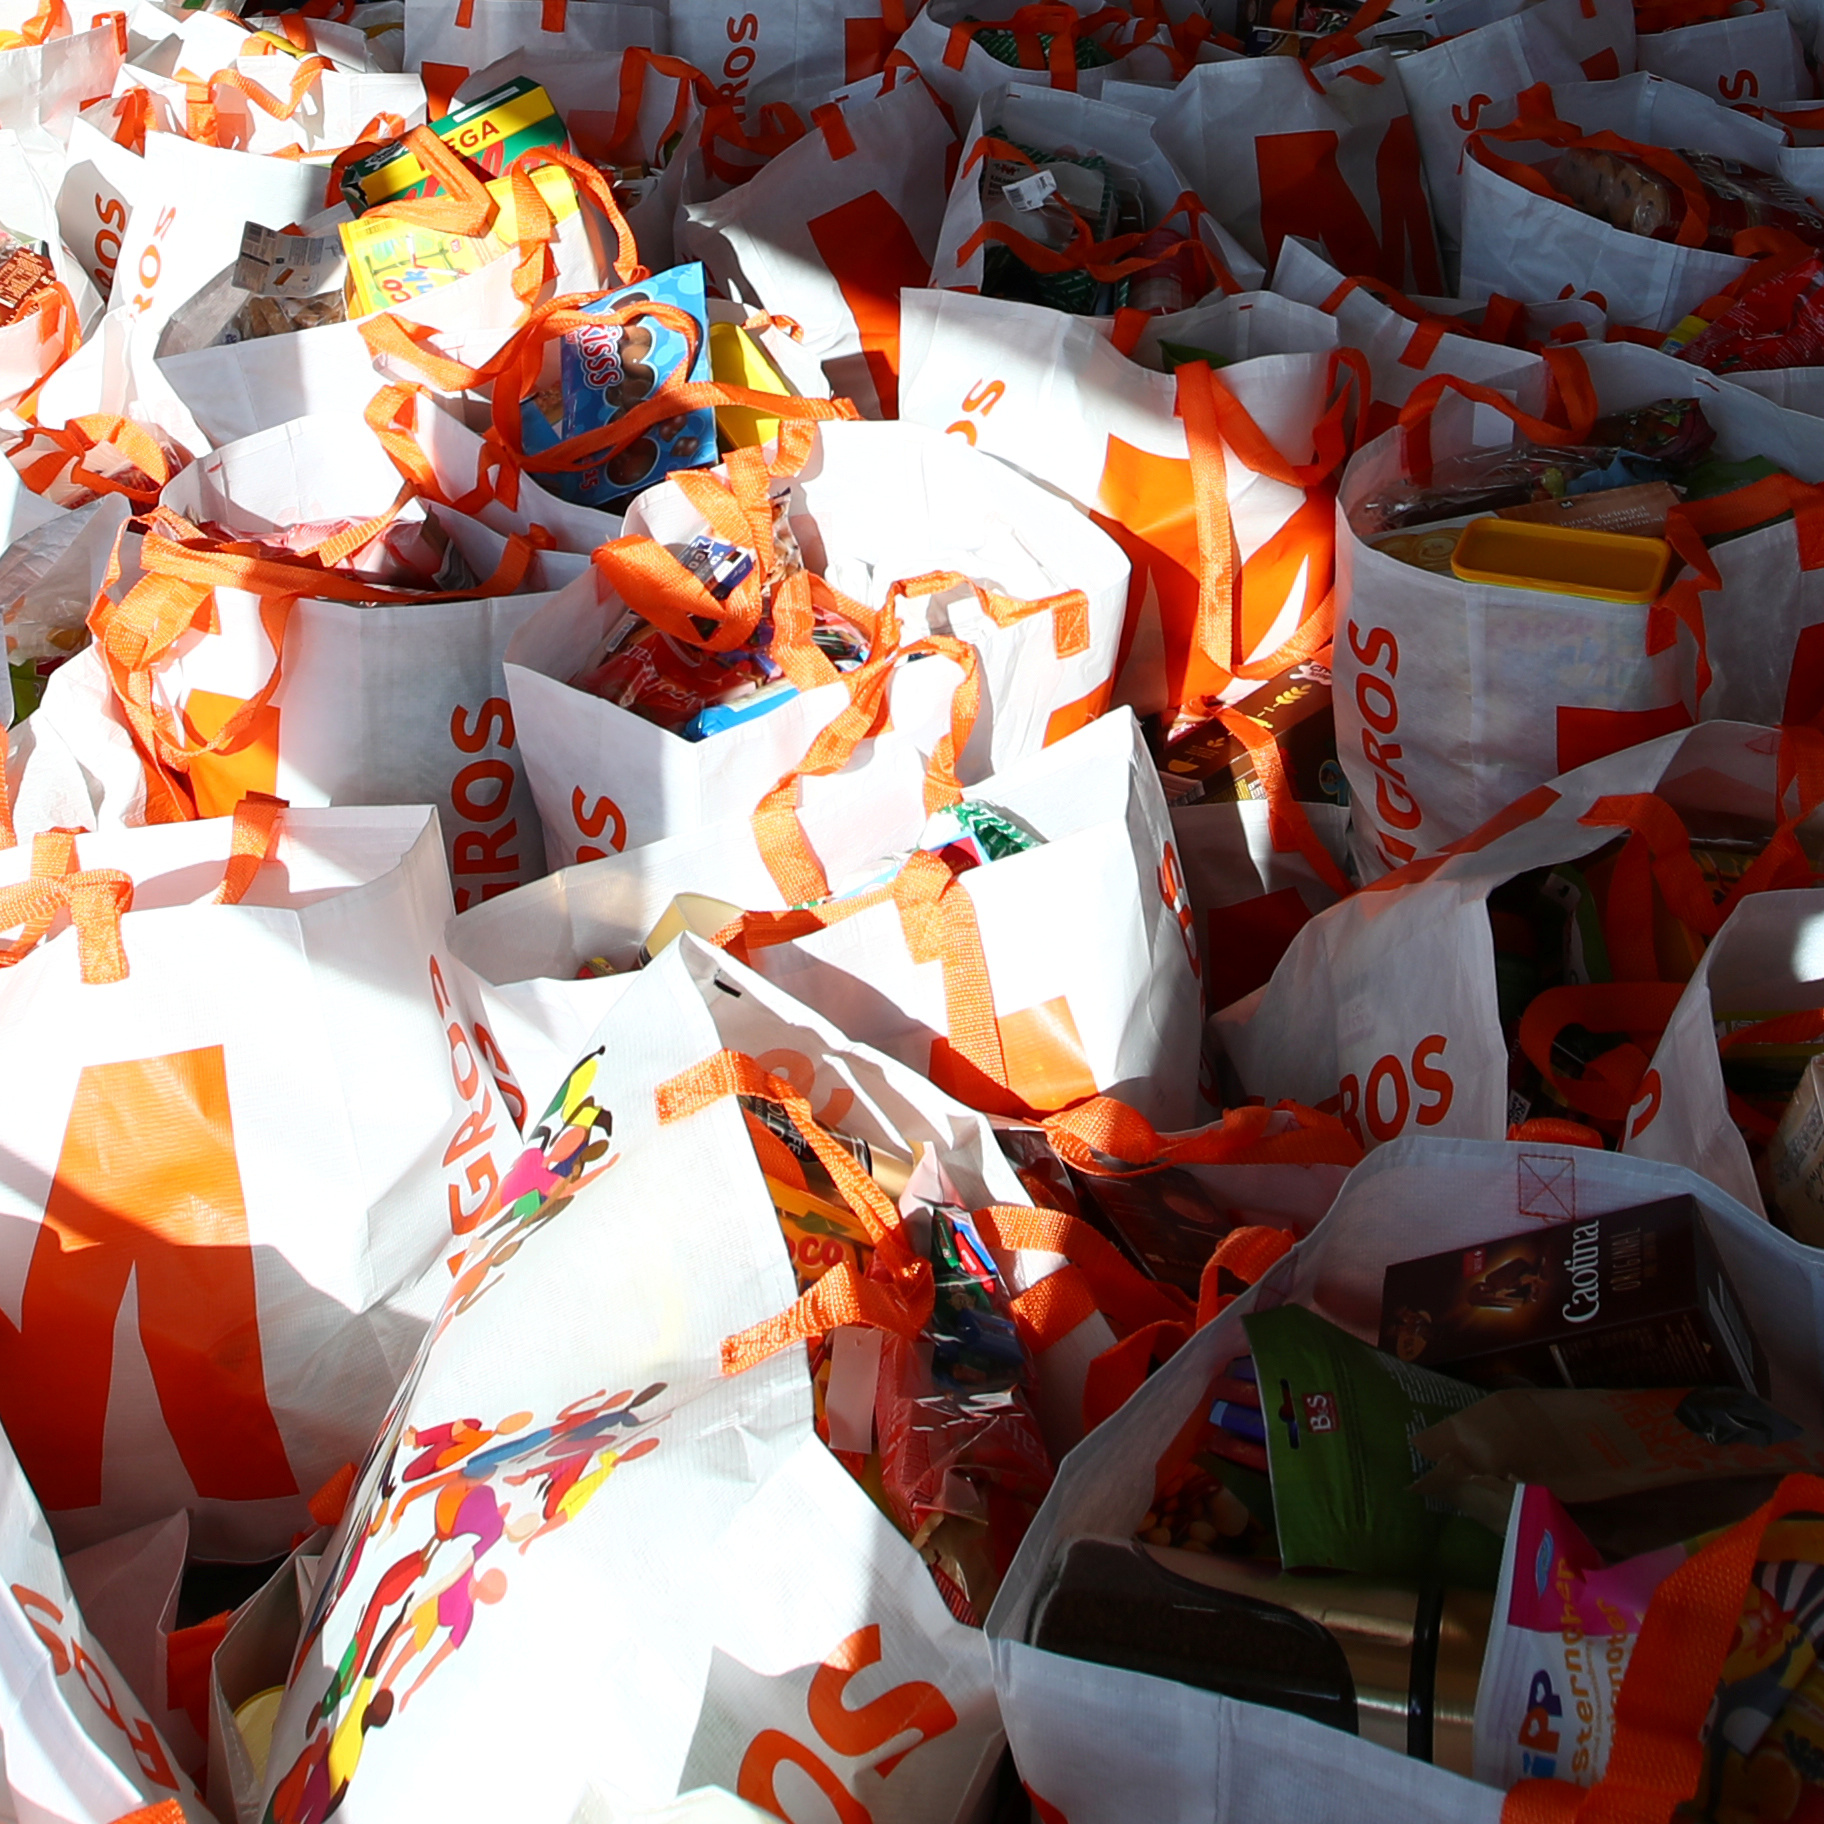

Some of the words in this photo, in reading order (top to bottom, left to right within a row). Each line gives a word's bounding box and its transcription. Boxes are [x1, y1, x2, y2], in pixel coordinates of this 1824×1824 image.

[721, 11, 759, 124] ROS
[1348, 619, 1422, 870] IGROS
[1336, 1034, 1455, 1151] ROS
[1562, 1219, 1600, 1325] Caotina
